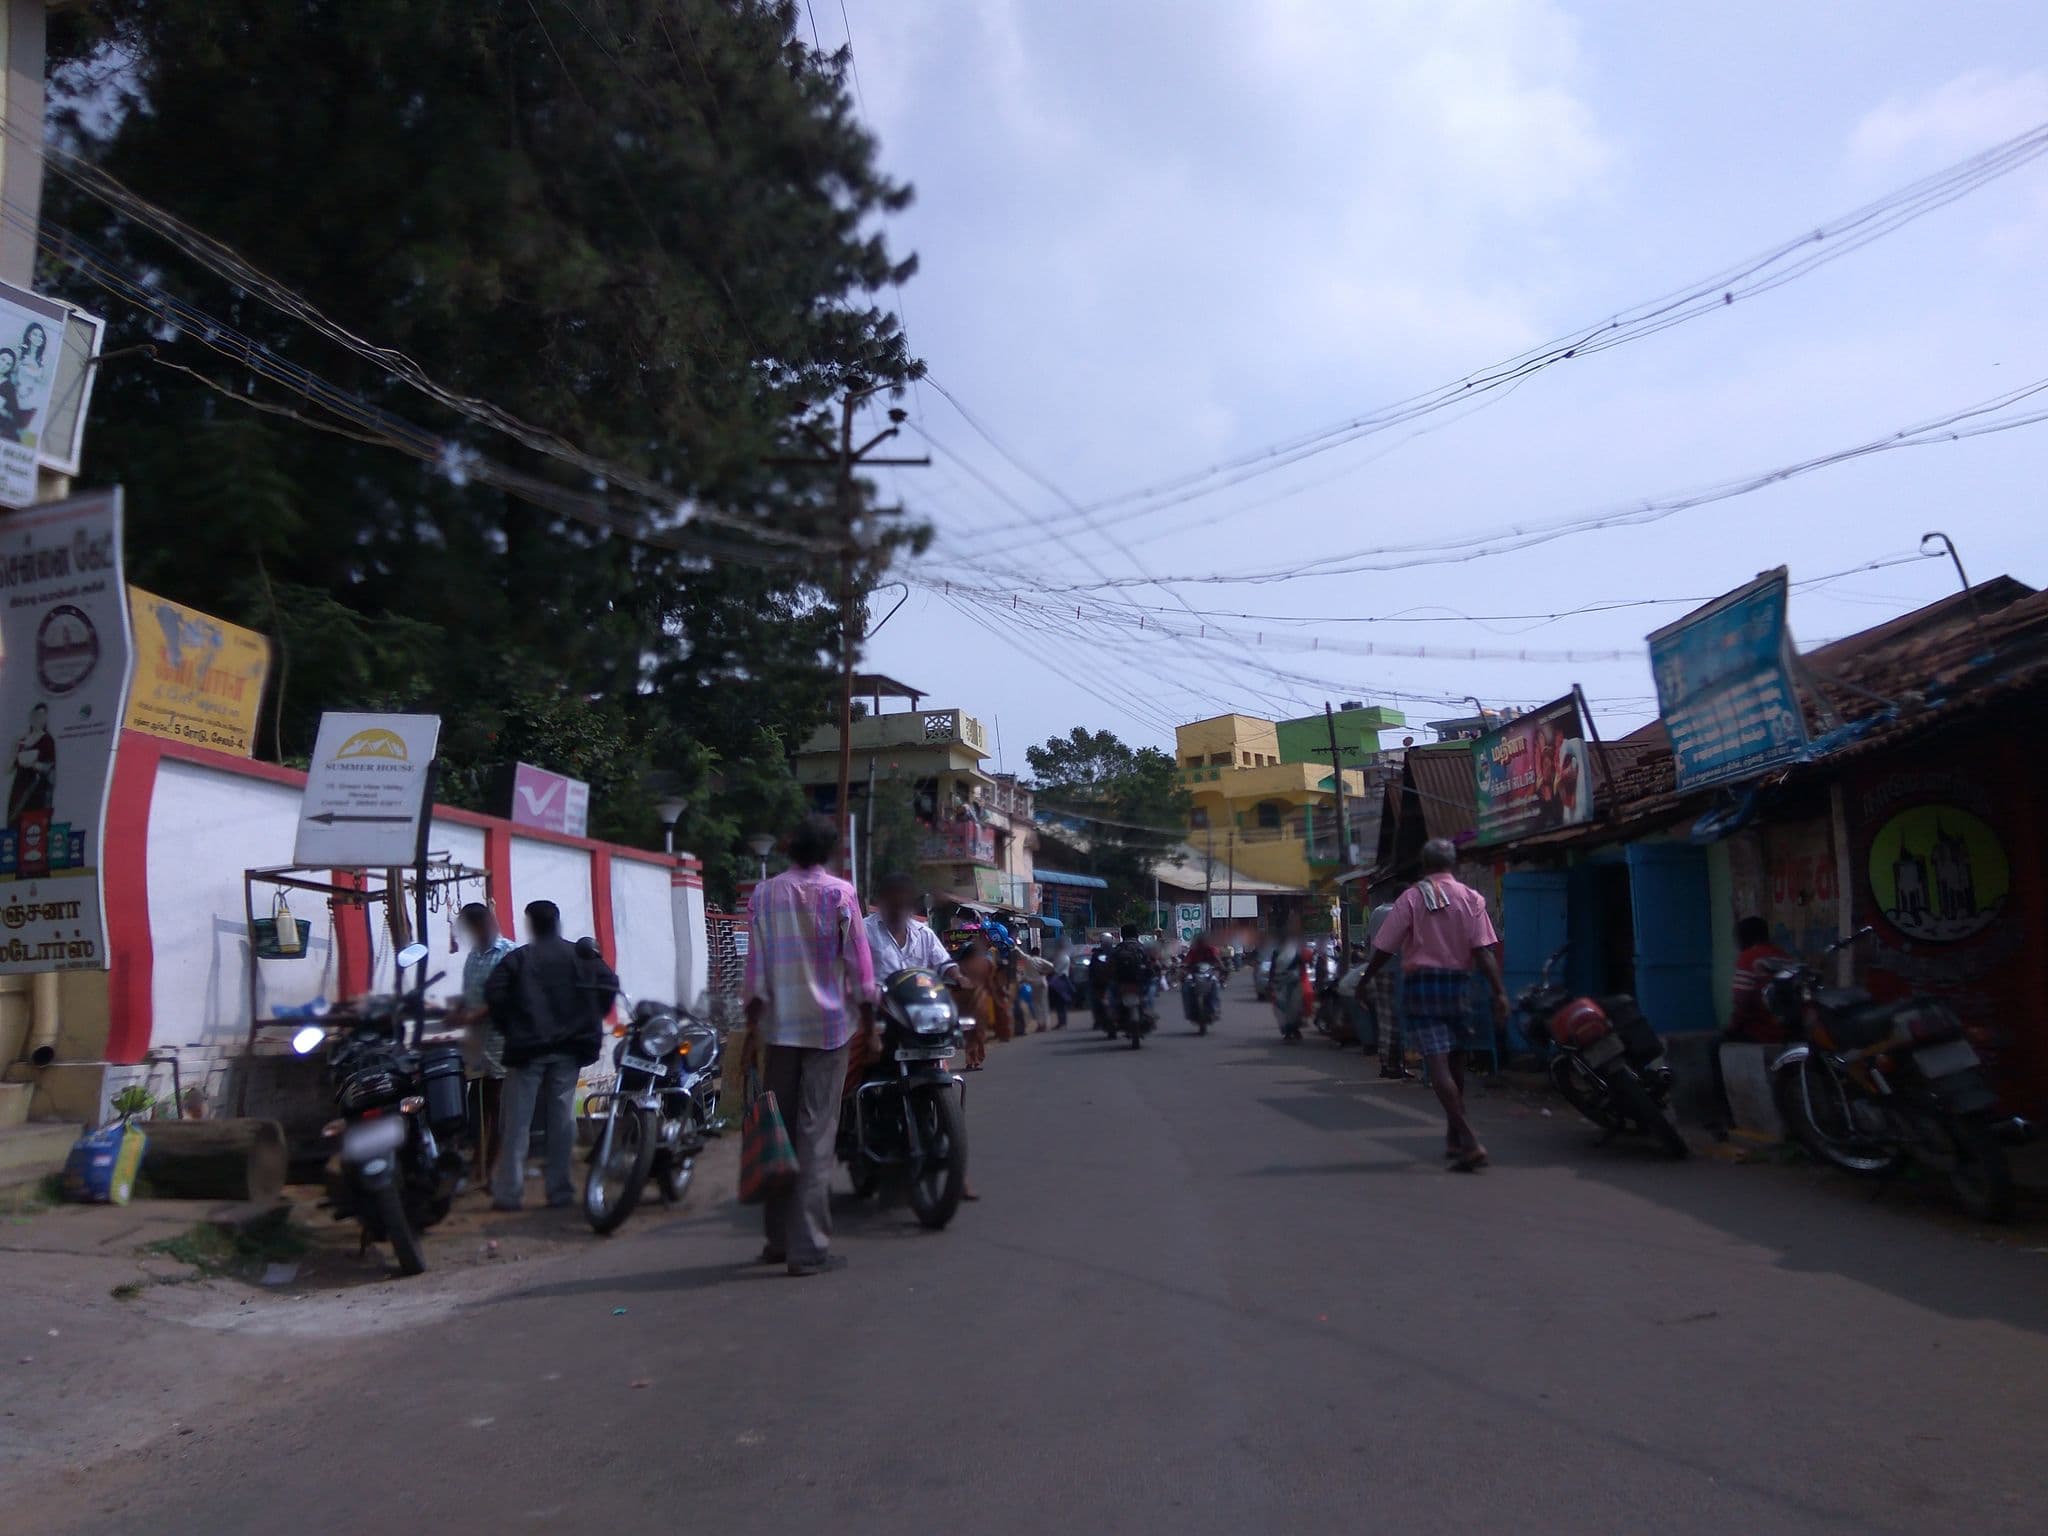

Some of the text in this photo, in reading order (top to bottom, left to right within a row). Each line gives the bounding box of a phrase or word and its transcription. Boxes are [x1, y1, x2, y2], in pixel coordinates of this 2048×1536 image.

[174, 723, 181, 735] 5
[325, 763, 415, 772] SUMMER HOUSE
[0, 895, 81, 929] ஞ்சனா
